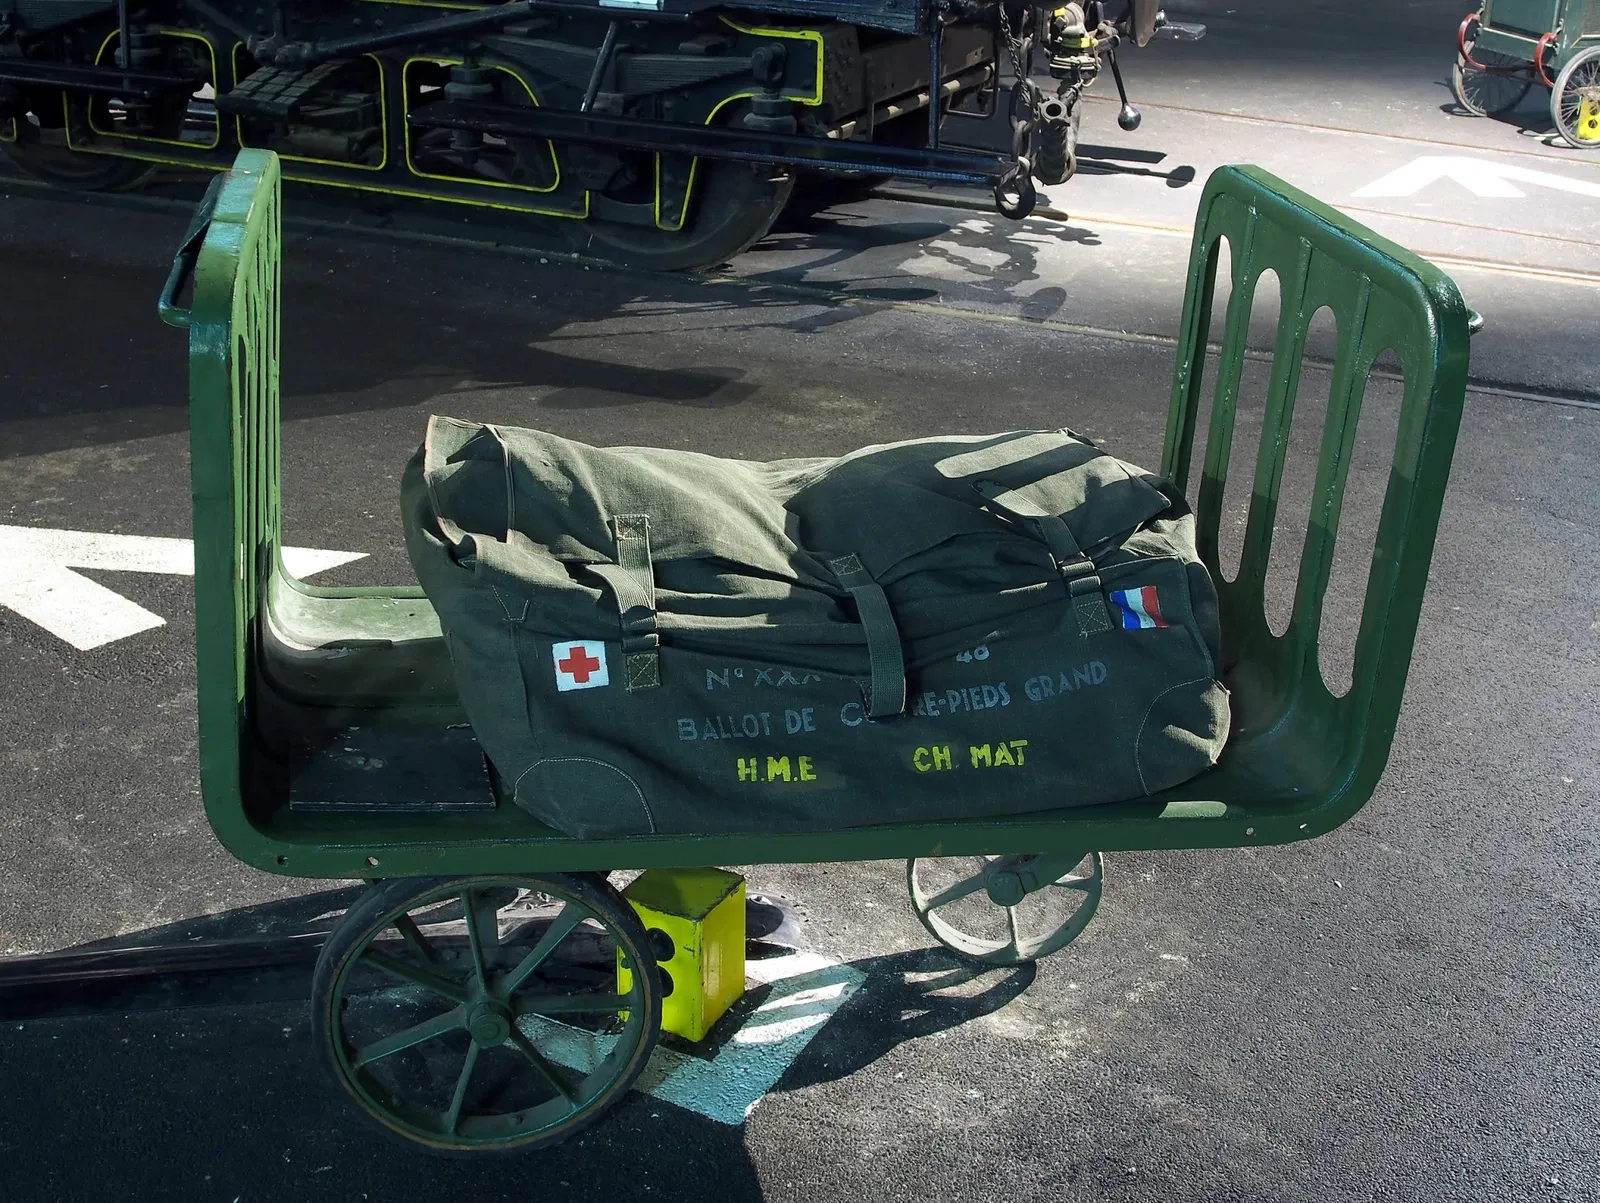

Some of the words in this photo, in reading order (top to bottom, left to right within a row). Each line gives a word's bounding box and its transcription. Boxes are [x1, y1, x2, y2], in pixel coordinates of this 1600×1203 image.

[676, 711, 770, 741] BALLOT
[784, 707, 817, 734] DE
[1024, 660, 1108, 701] GRAND
[970, 739, 1029, 769] MAT
